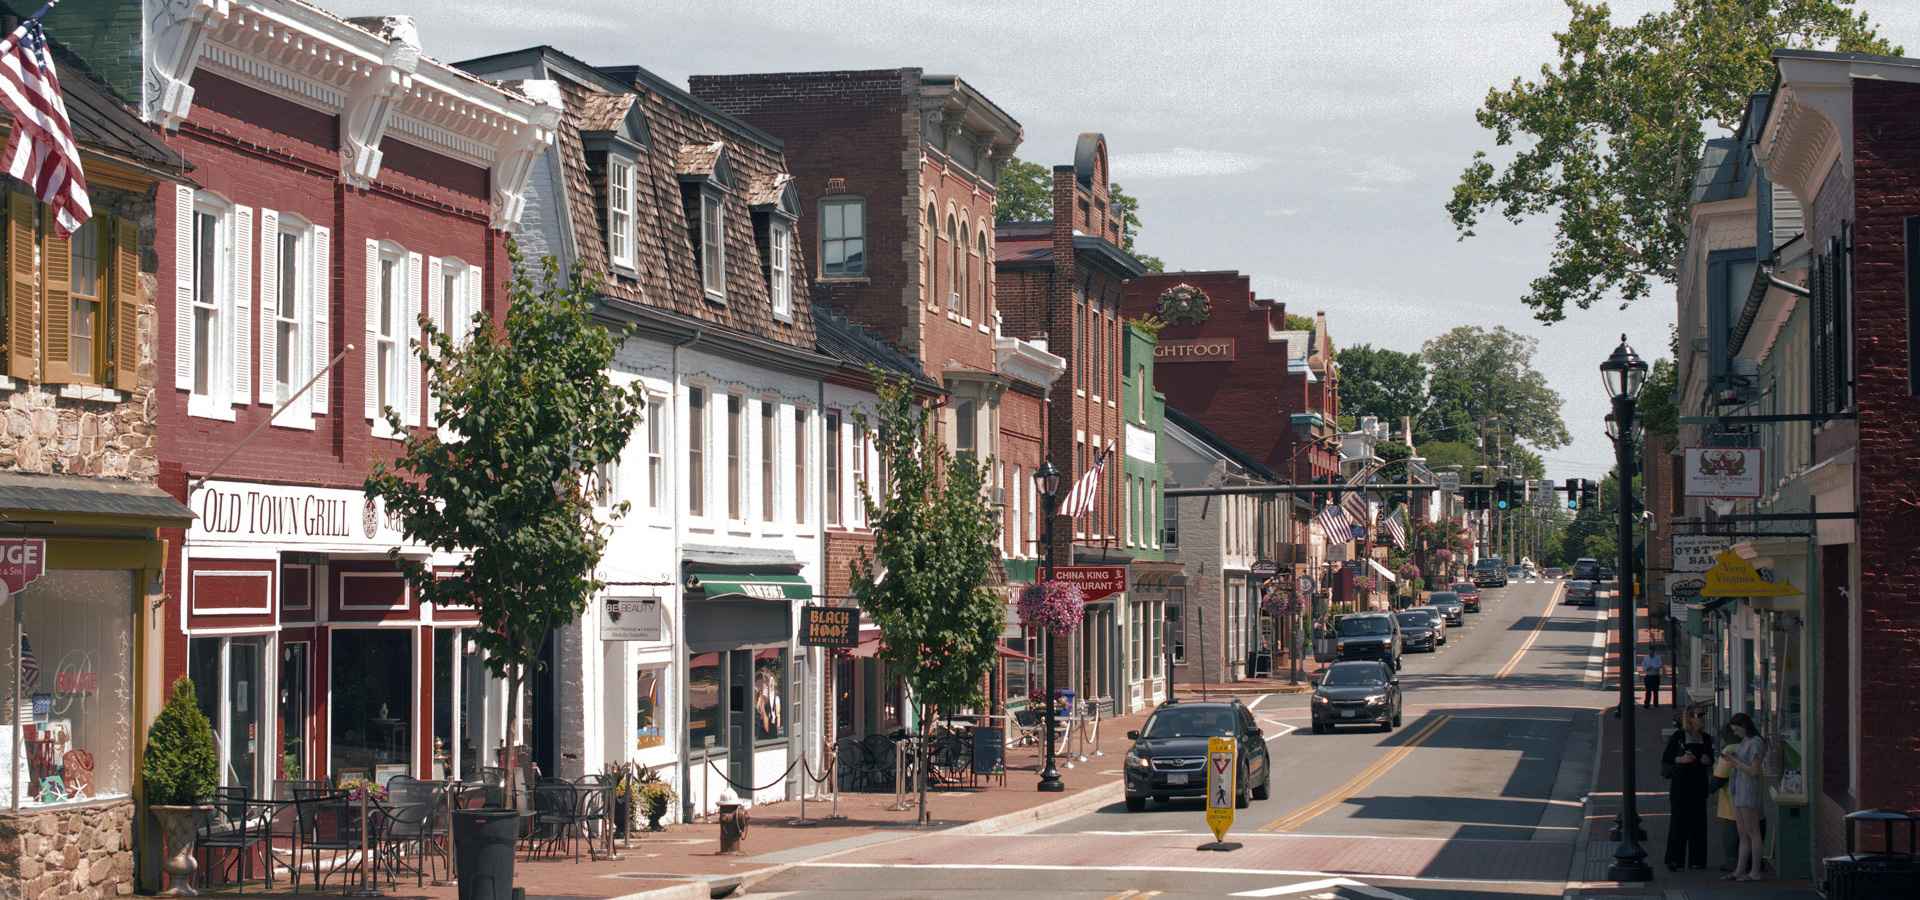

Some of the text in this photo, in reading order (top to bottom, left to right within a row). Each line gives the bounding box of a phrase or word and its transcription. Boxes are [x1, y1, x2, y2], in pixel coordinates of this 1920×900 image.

[203, 488, 350, 537] OLD TOWN GRILL
[384, 503, 405, 534] Sea
[1056, 571, 1109, 580] CHINA KING
[607, 603, 655, 613] BE BEAUTY
